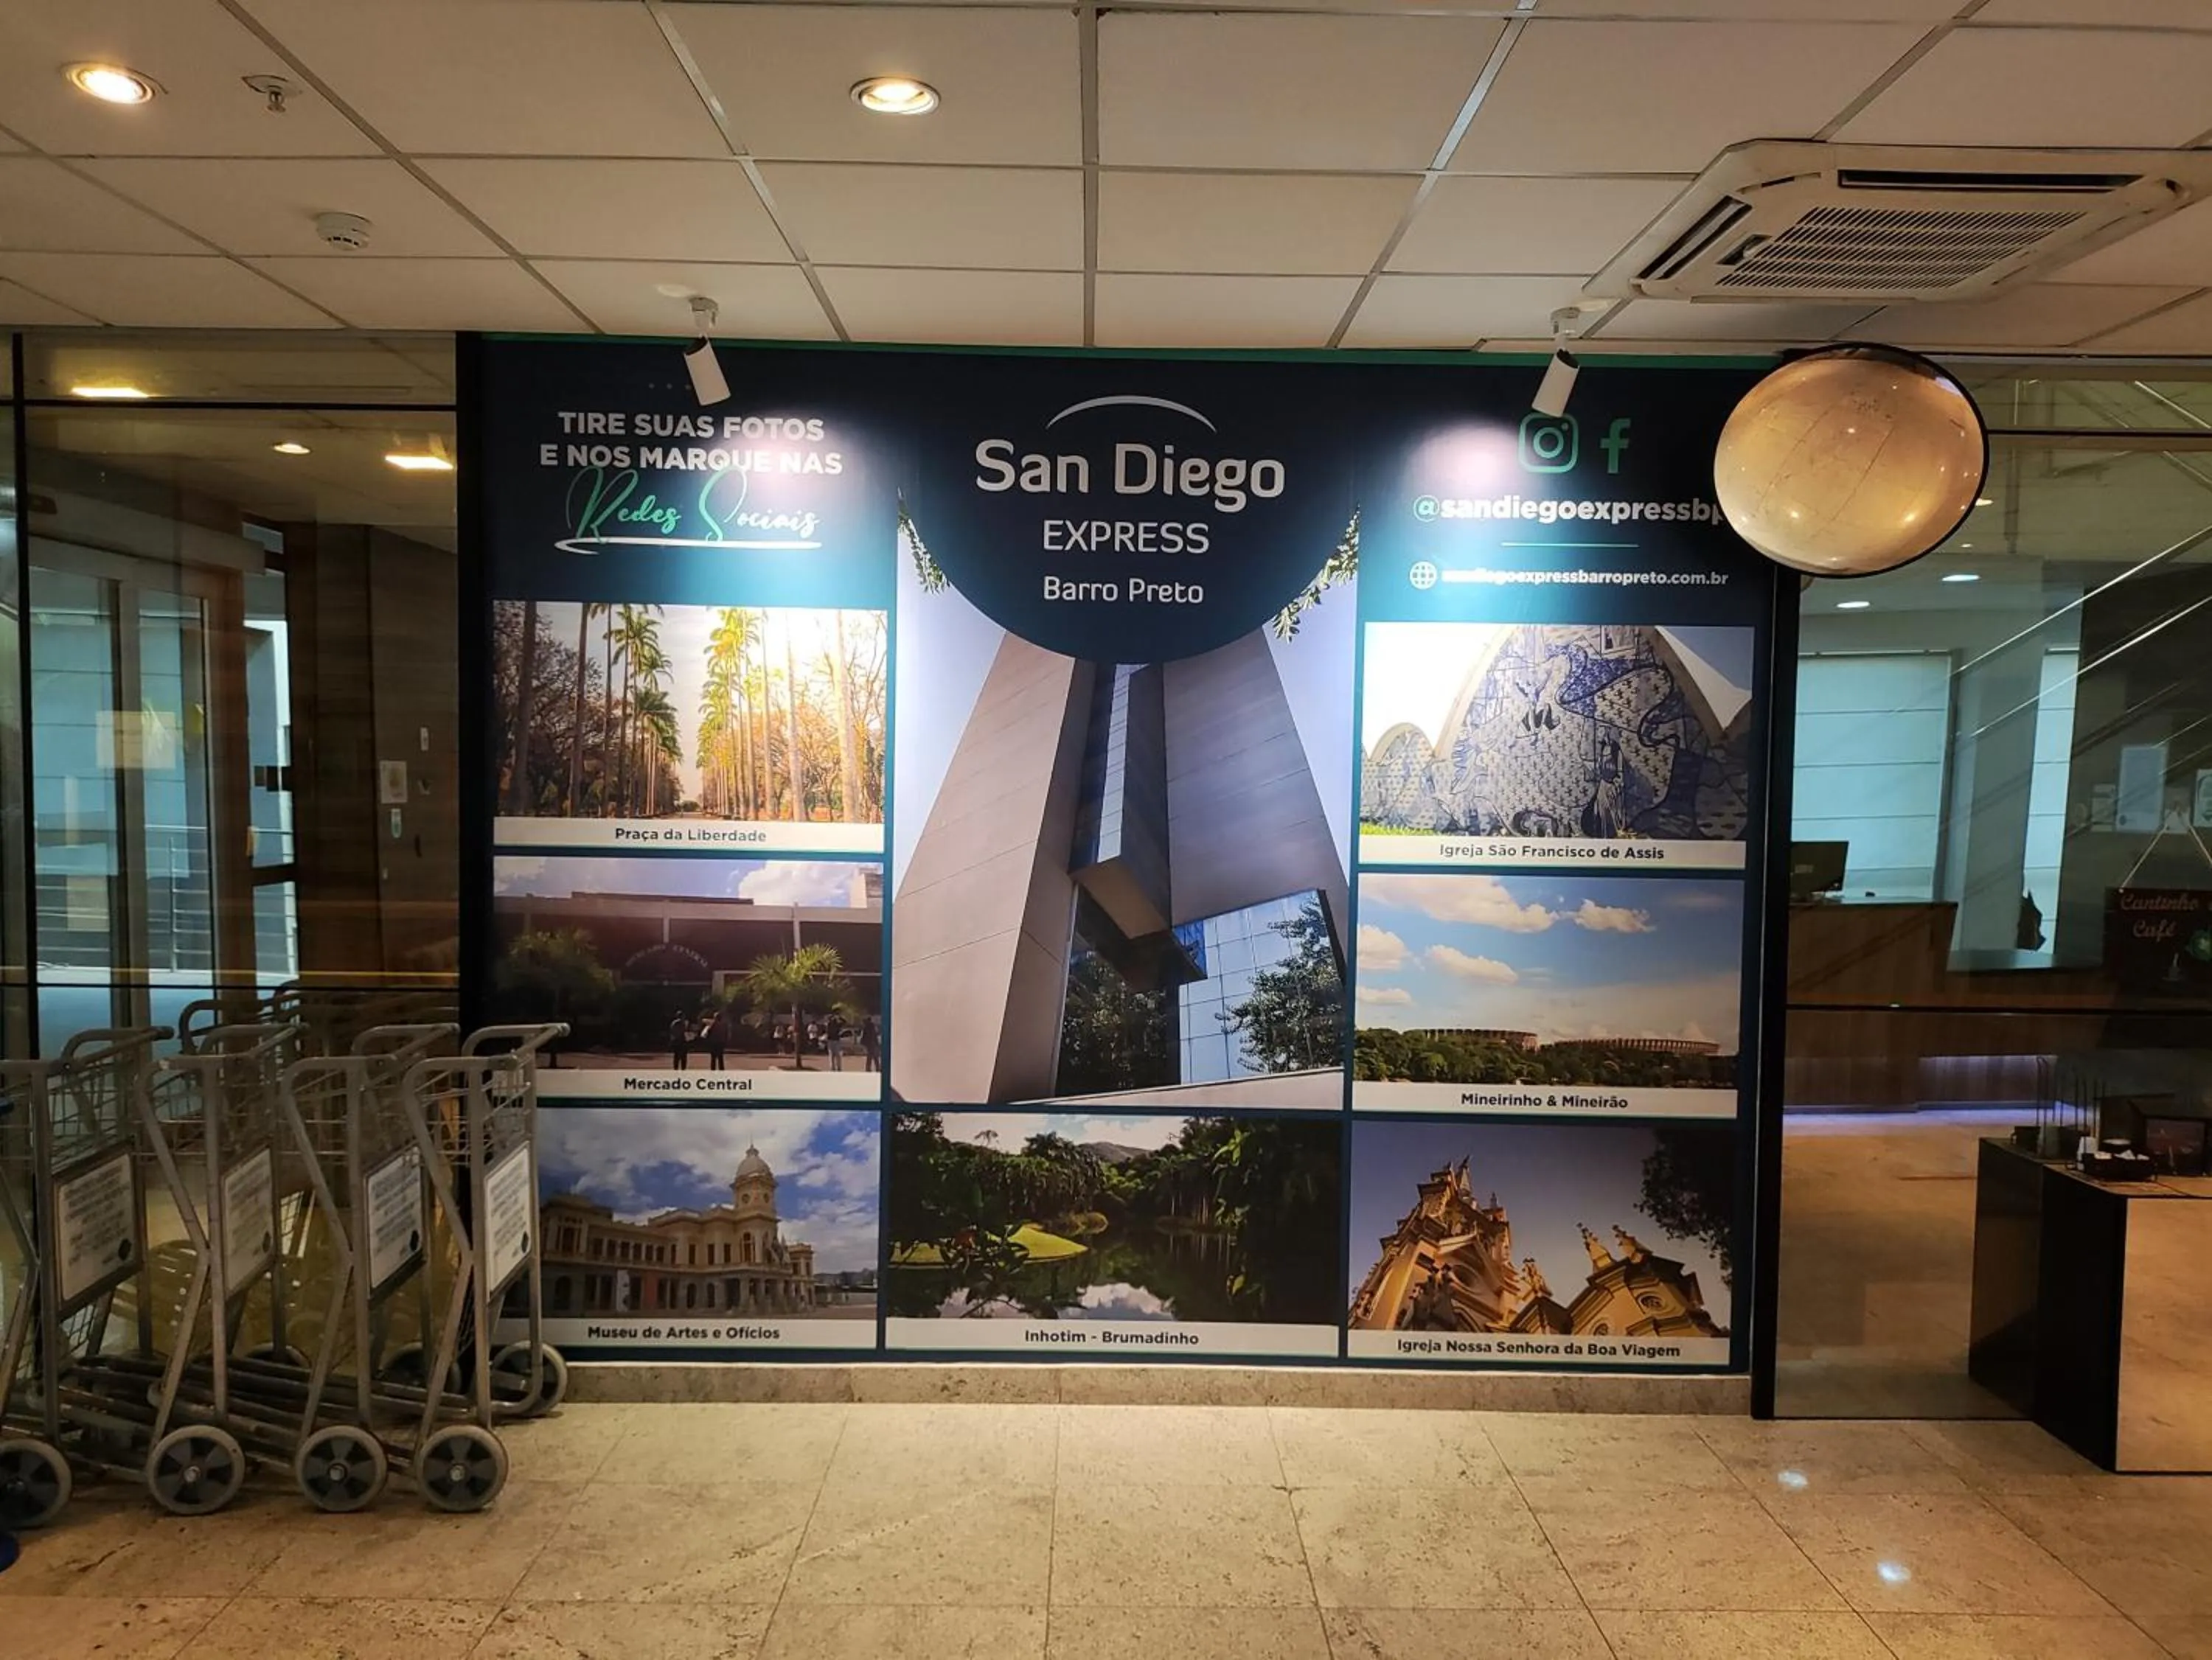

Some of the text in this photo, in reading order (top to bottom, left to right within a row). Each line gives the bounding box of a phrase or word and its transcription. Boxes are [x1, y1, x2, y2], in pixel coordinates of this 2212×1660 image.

[558, 411, 825, 442] TIRE SUAS FOTOS
[540, 444, 843, 475] E NOS MARQUE NAS
[975, 439, 1286, 513] San Diego
[566, 465, 682, 544] Redes
[1043, 519, 1210, 554] EXPRESS
[1441, 568, 1729, 585] egoexpressbarropreto.com.br
[1043, 576, 1204, 604] Barro Preto
[615, 828, 766, 843] Praça da Liberdade
[1440, 843, 1665, 859] Igreja São Francisco de Assis
[2132, 919, 2178, 943] Café
[624, 1078, 752, 1091] Mercado Central
[1461, 1092, 1629, 1109] Mineirinho & Mineirão
[588, 1325, 780, 1340] Museu de Artes e Ofícios
[1025, 1330, 1087, 1343] Inhotim
[1102, 1331, 1199, 1345] Brumadinho
[1397, 1339, 1681, 1359] Igreja Nossa Senhora da Boa Viagem
